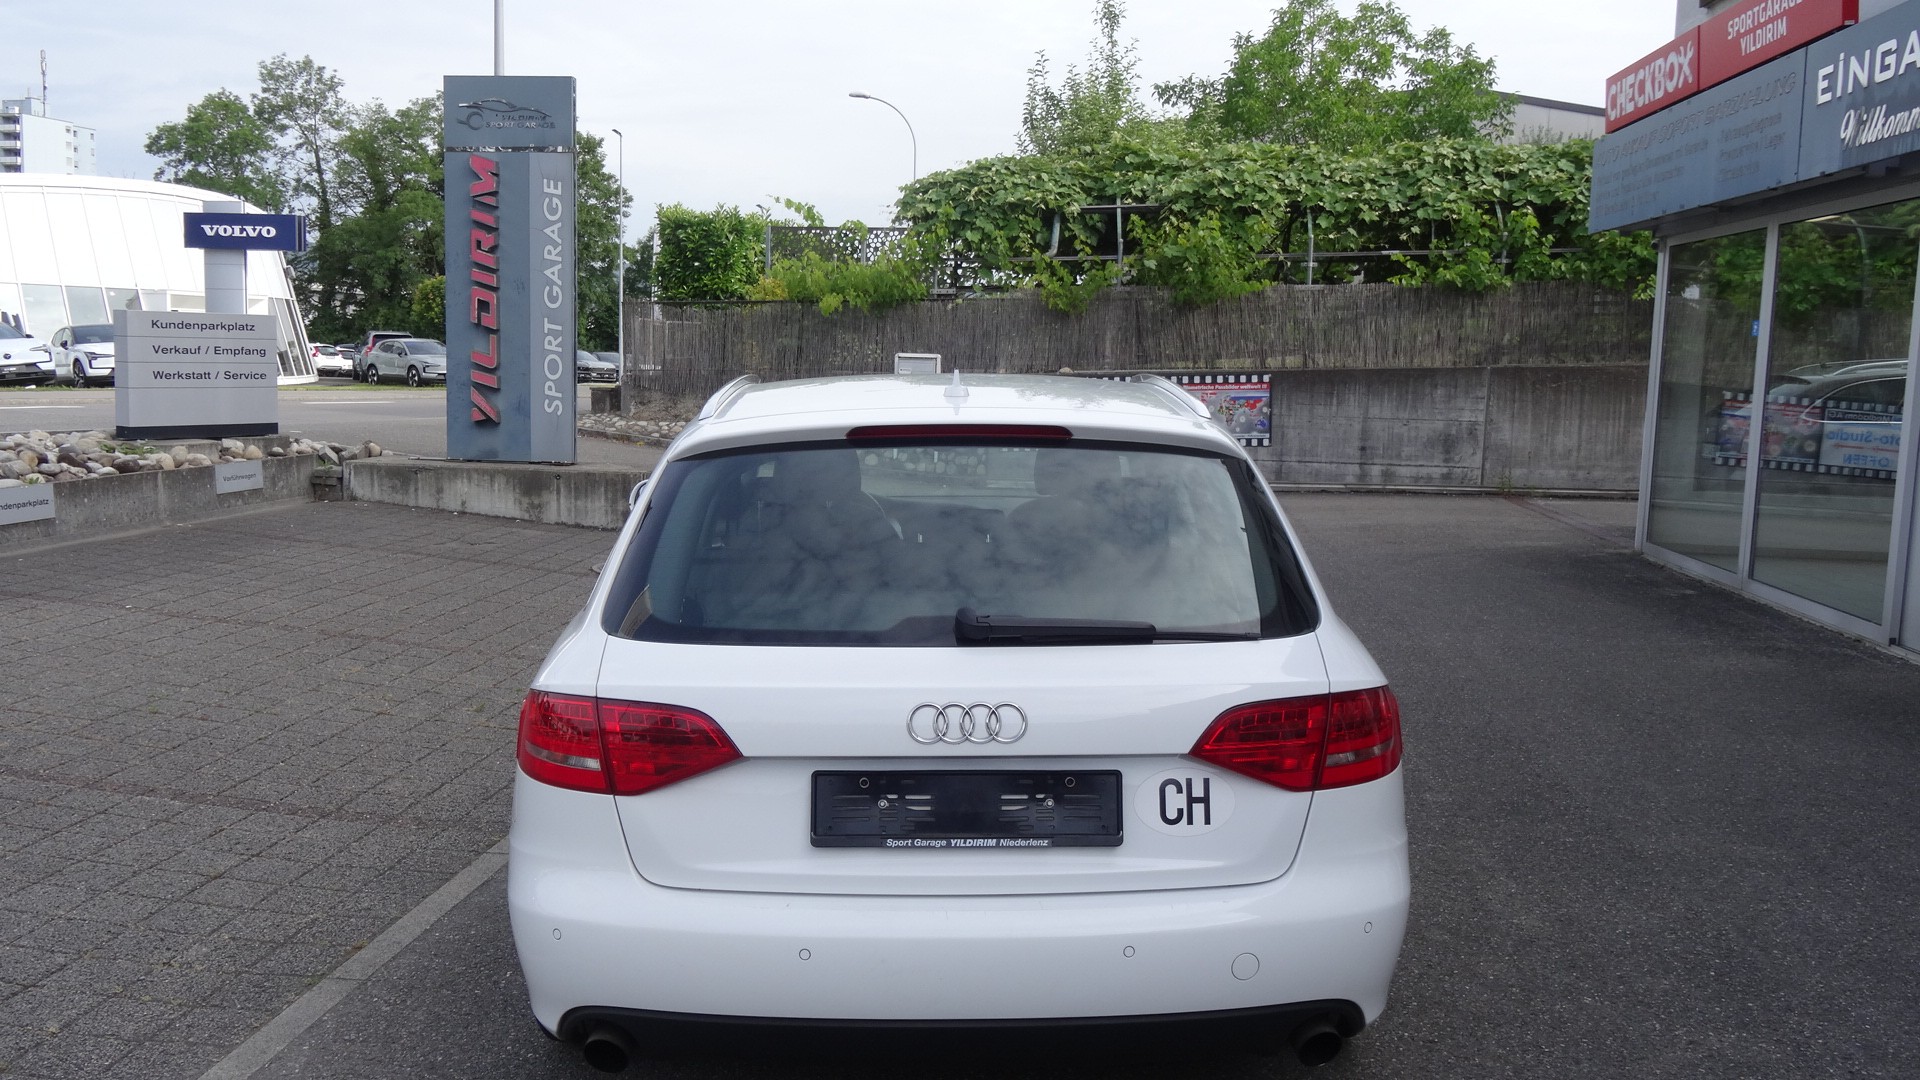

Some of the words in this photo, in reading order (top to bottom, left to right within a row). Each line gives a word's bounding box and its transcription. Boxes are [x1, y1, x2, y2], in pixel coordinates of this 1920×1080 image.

[1740, 16, 1787, 56] YILDIRIM
[1606, 40, 1695, 121] CHECKBOX
[485, 121, 515, 129] SPORT
[516, 121, 556, 129] GARAGE
[1658, 111, 1704, 144] SOFORT
[1704, 71, 1797, 125] BARZAHLUNG
[200, 224, 277, 238] VOLVO
[543, 177, 563, 309] GARAGE
[470, 154, 499, 424] YILDIRIM
[151, 319, 256, 333] Kundenparkplatz
[152, 344, 201, 355] Verkauf
[204, 346, 210, 355] /
[213, 345, 267, 358] Empfang
[543, 317, 563, 416] SPORT
[152, 370, 211, 380] Werkstatt
[214, 370, 220, 380] /
[223, 370, 267, 380] Service
[1159, 777, 1211, 826] CH
[886, 838, 912, 847] Sport
[914, 838, 947, 847] Garage
[950, 838, 997, 847] YILDIRIM
[999, 838, 1049, 847] Niederlenz
